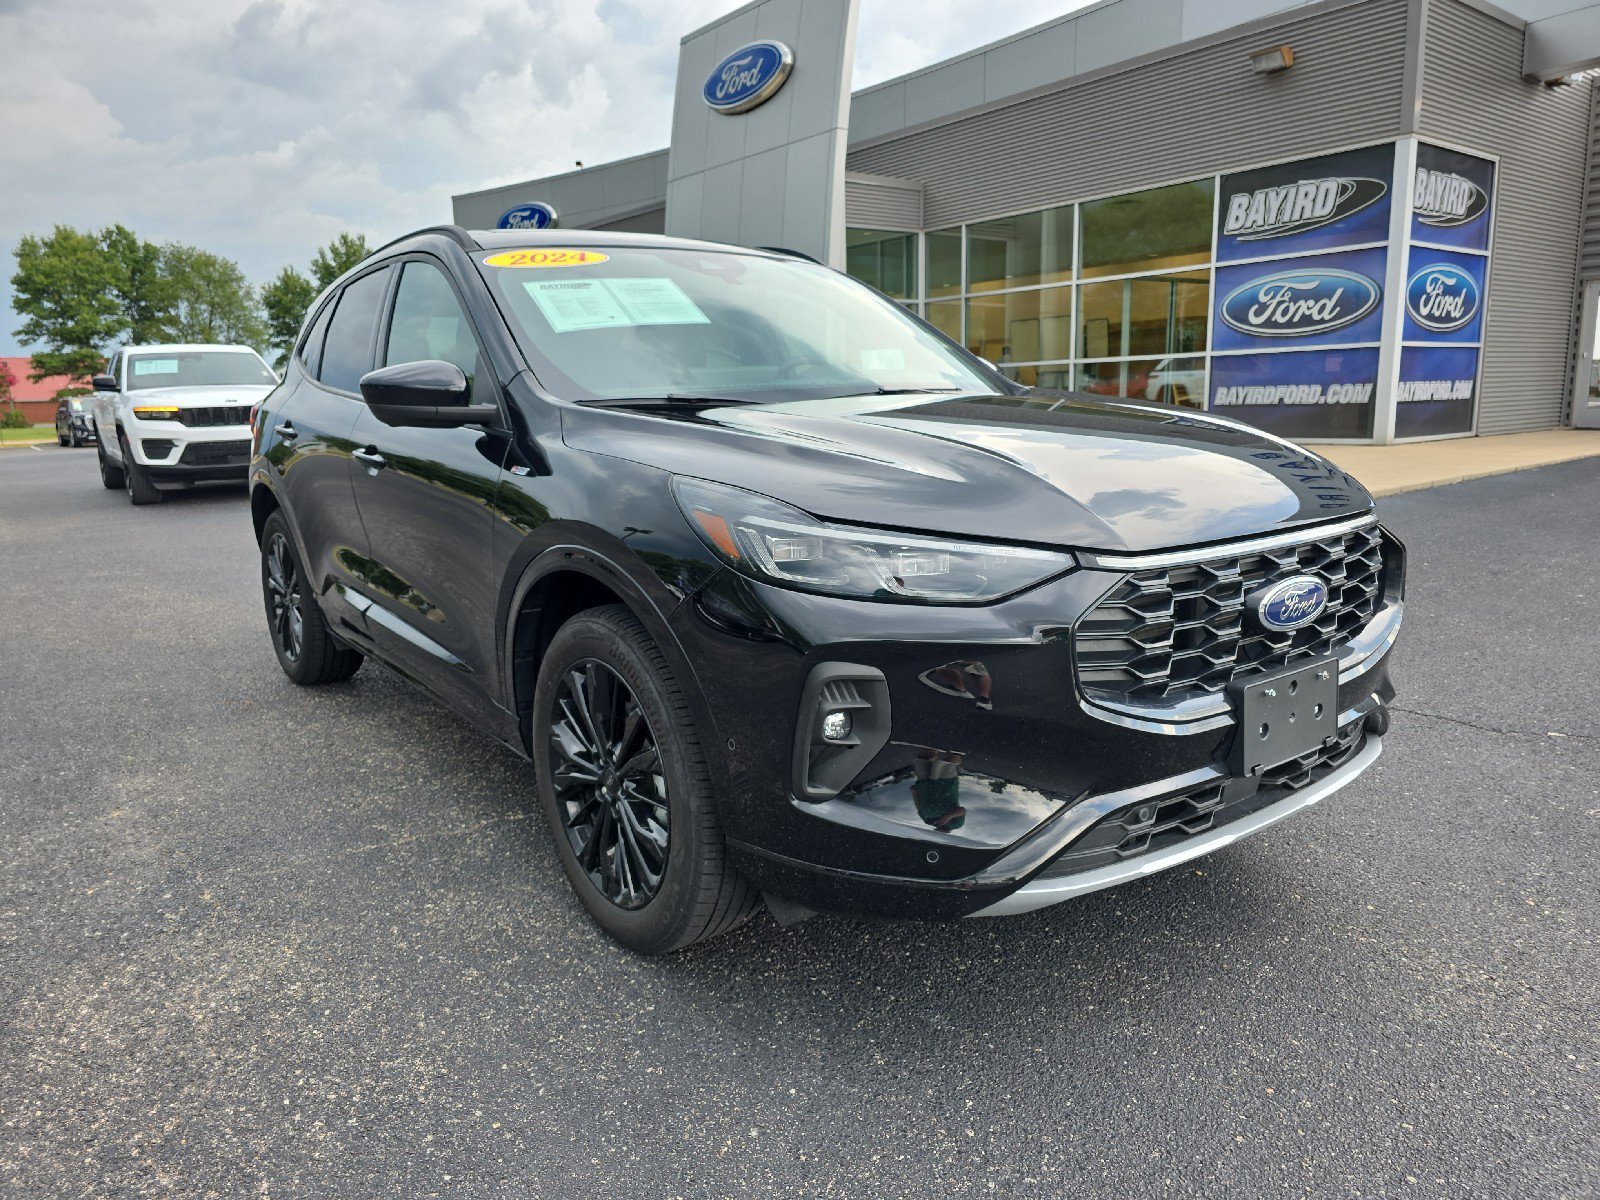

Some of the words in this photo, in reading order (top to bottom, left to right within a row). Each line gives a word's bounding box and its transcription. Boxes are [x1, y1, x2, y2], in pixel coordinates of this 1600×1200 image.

[716, 54, 765, 98] Ford
[1226, 177, 1340, 232] BAYIRD
[1413, 168, 1471, 216] BAYIRD
[508, 211, 540, 229] Ford
[510, 251, 588, 266] 2024
[1248, 280, 1344, 324] Ford
[1420, 273, 1466, 319] Ford
[1214, 383, 1373, 405] BAYIRDFORD.COM
[1279, 589, 1318, 621] Ford
